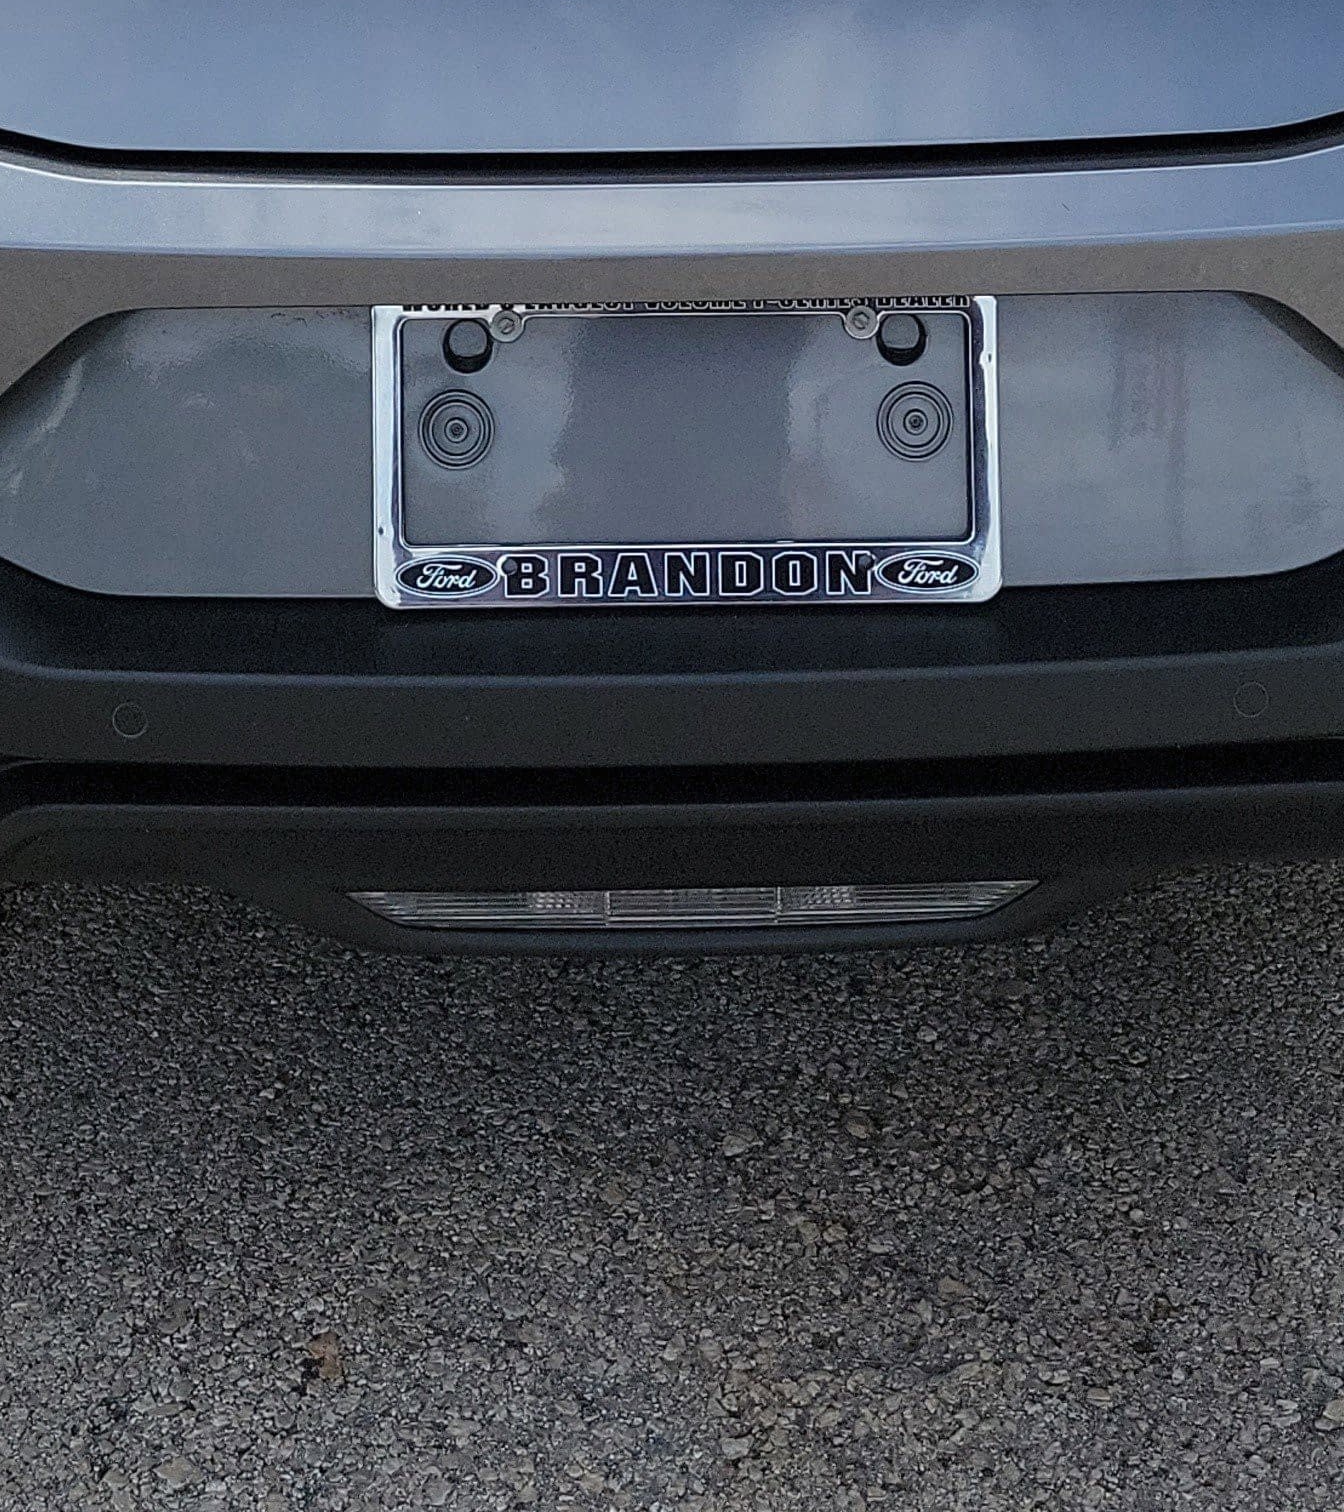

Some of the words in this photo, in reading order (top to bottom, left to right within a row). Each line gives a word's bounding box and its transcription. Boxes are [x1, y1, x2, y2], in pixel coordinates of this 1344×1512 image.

[417, 563, 478, 589] Ford
[503, 551, 873, 598] BRANDON
[897, 558, 959, 584] Ford
